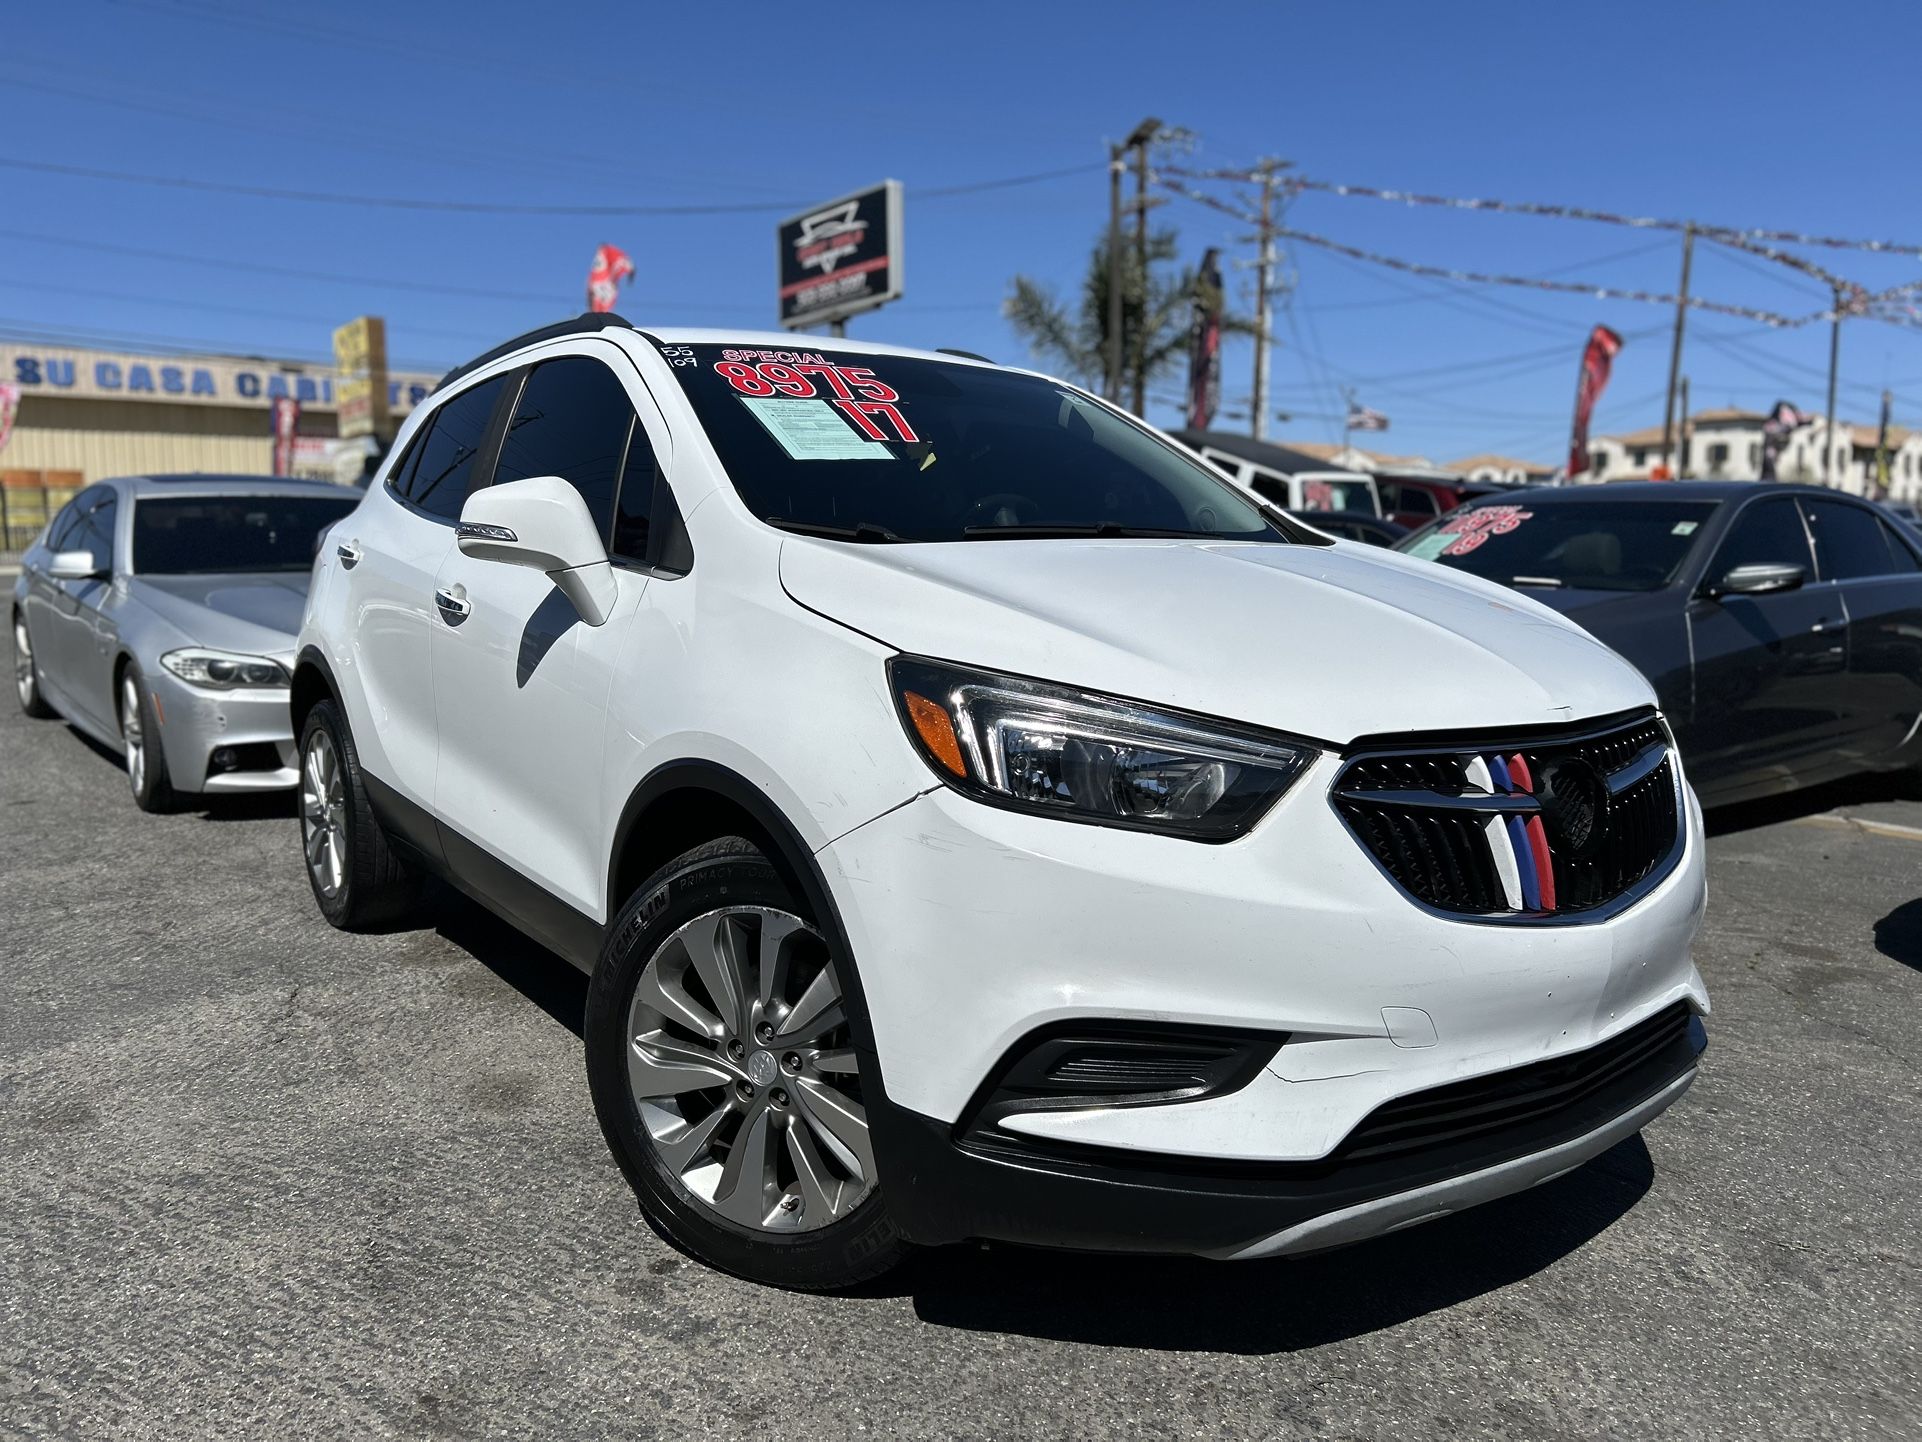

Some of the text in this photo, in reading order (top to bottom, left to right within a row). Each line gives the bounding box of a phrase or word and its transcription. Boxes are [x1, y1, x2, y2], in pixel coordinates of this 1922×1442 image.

[15, 357, 74, 386] SU
[95, 362, 216, 396] CASA
[722, 350, 834, 365] SPECIAL
[714, 361, 899, 402] 8975
[832, 400, 919, 442] 17
[680, 868, 733, 889] PRIMACY
[606, 892, 667, 980] MICHELIN
